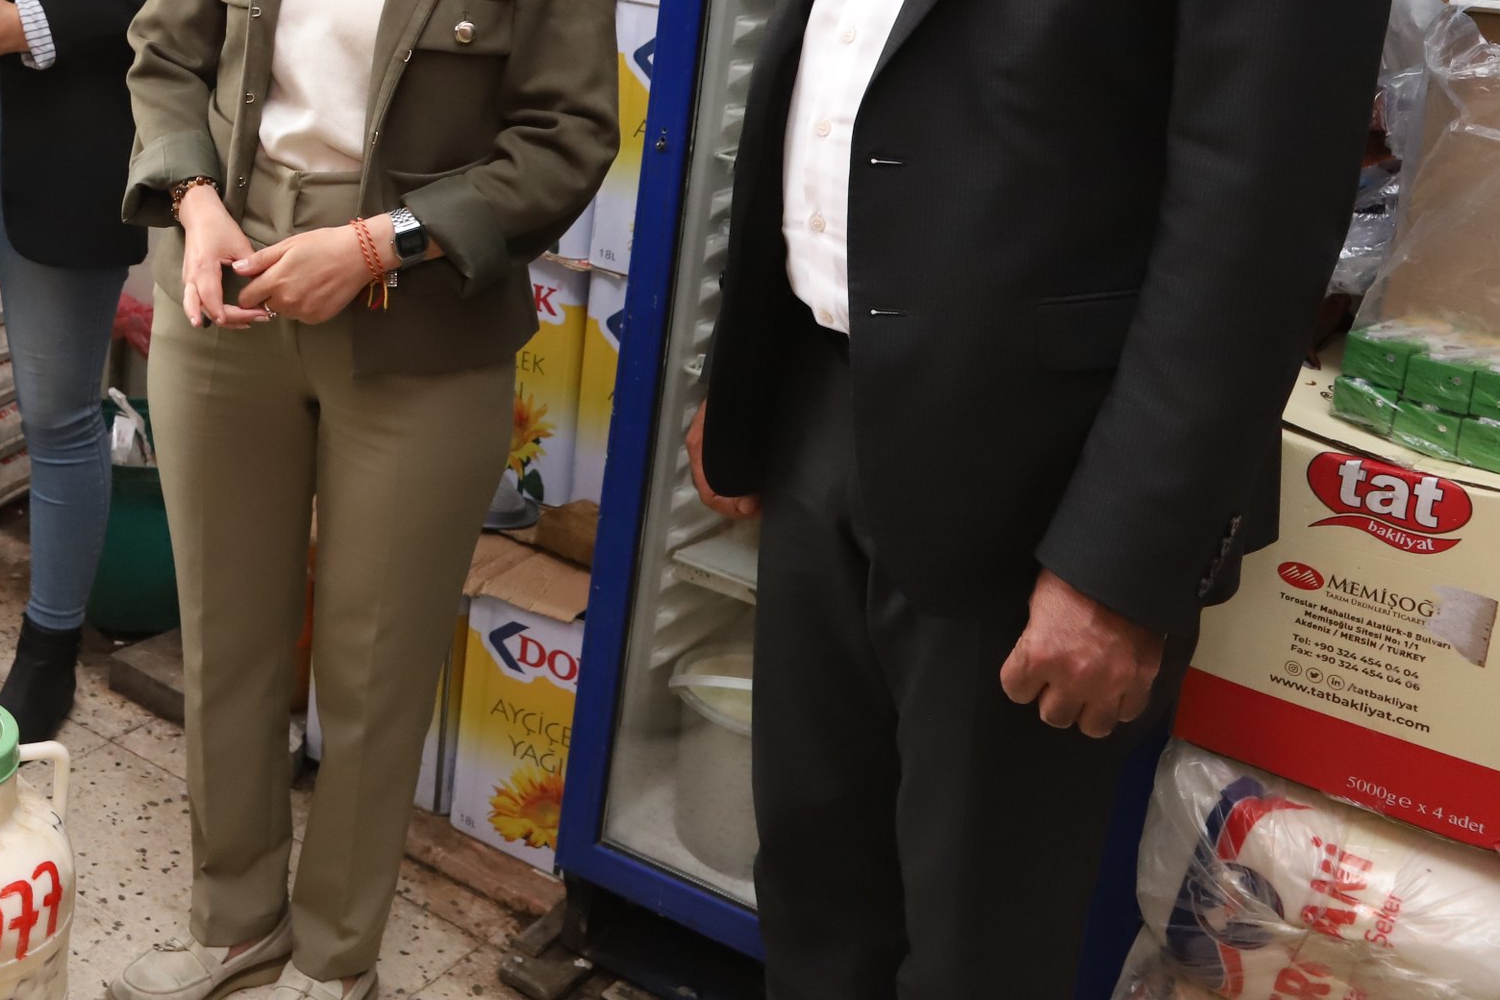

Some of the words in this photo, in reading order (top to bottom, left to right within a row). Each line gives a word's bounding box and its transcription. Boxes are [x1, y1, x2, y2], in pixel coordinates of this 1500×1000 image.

[599, 248, 617, 262] 18L
[1338, 459, 1443, 528] tat
[1367, 520, 1434, 551] bakliyat
[1279, 592, 1318, 610] Toroslar
[1319, 605, 1364, 624] Mahallesi
[1327, 574, 1438, 618] MEMİŞOĞ
[1295, 617, 1331, 636] Akdeniz
[1340, 631, 1377, 649] MERSİN
[1304, 610, 1354, 632] Memişoğlu
[1355, 626, 1382, 641] Sitesi
[1404, 640, 1419, 651] 1/1
[517, 634, 581, 685] DO
[1290, 644, 1312, 657] Fax:
[1315, 653, 1336, 664] +90
[1338, 659, 1359, 672] 324
[1361, 667, 1383, 680] 454
[1386, 675, 1402, 686] 04
[1405, 681, 1420, 691] 06
[1292, 633, 1311, 646] Tel:
[1314, 641, 1335, 653] +90
[1336, 648, 1357, 660] 324
[1360, 655, 1382, 668] 454
[1384, 663, 1401, 674] 04
[1403, 669, 1419, 679] 04
[1269, 673, 1431, 733] www.tatbakliyat.com
[1347, 683, 1419, 713] /tatbakliyat
[490, 698, 573, 749] AYÇİÇE
[508, 734, 564, 777] YAĞI
[459, 813, 477, 829] 18L
[1417, 803, 1427, 815] x
[1432, 807, 1444, 820] 4
[1448, 814, 1485, 835] adet
[1364, 894, 1402, 948] Şeker
